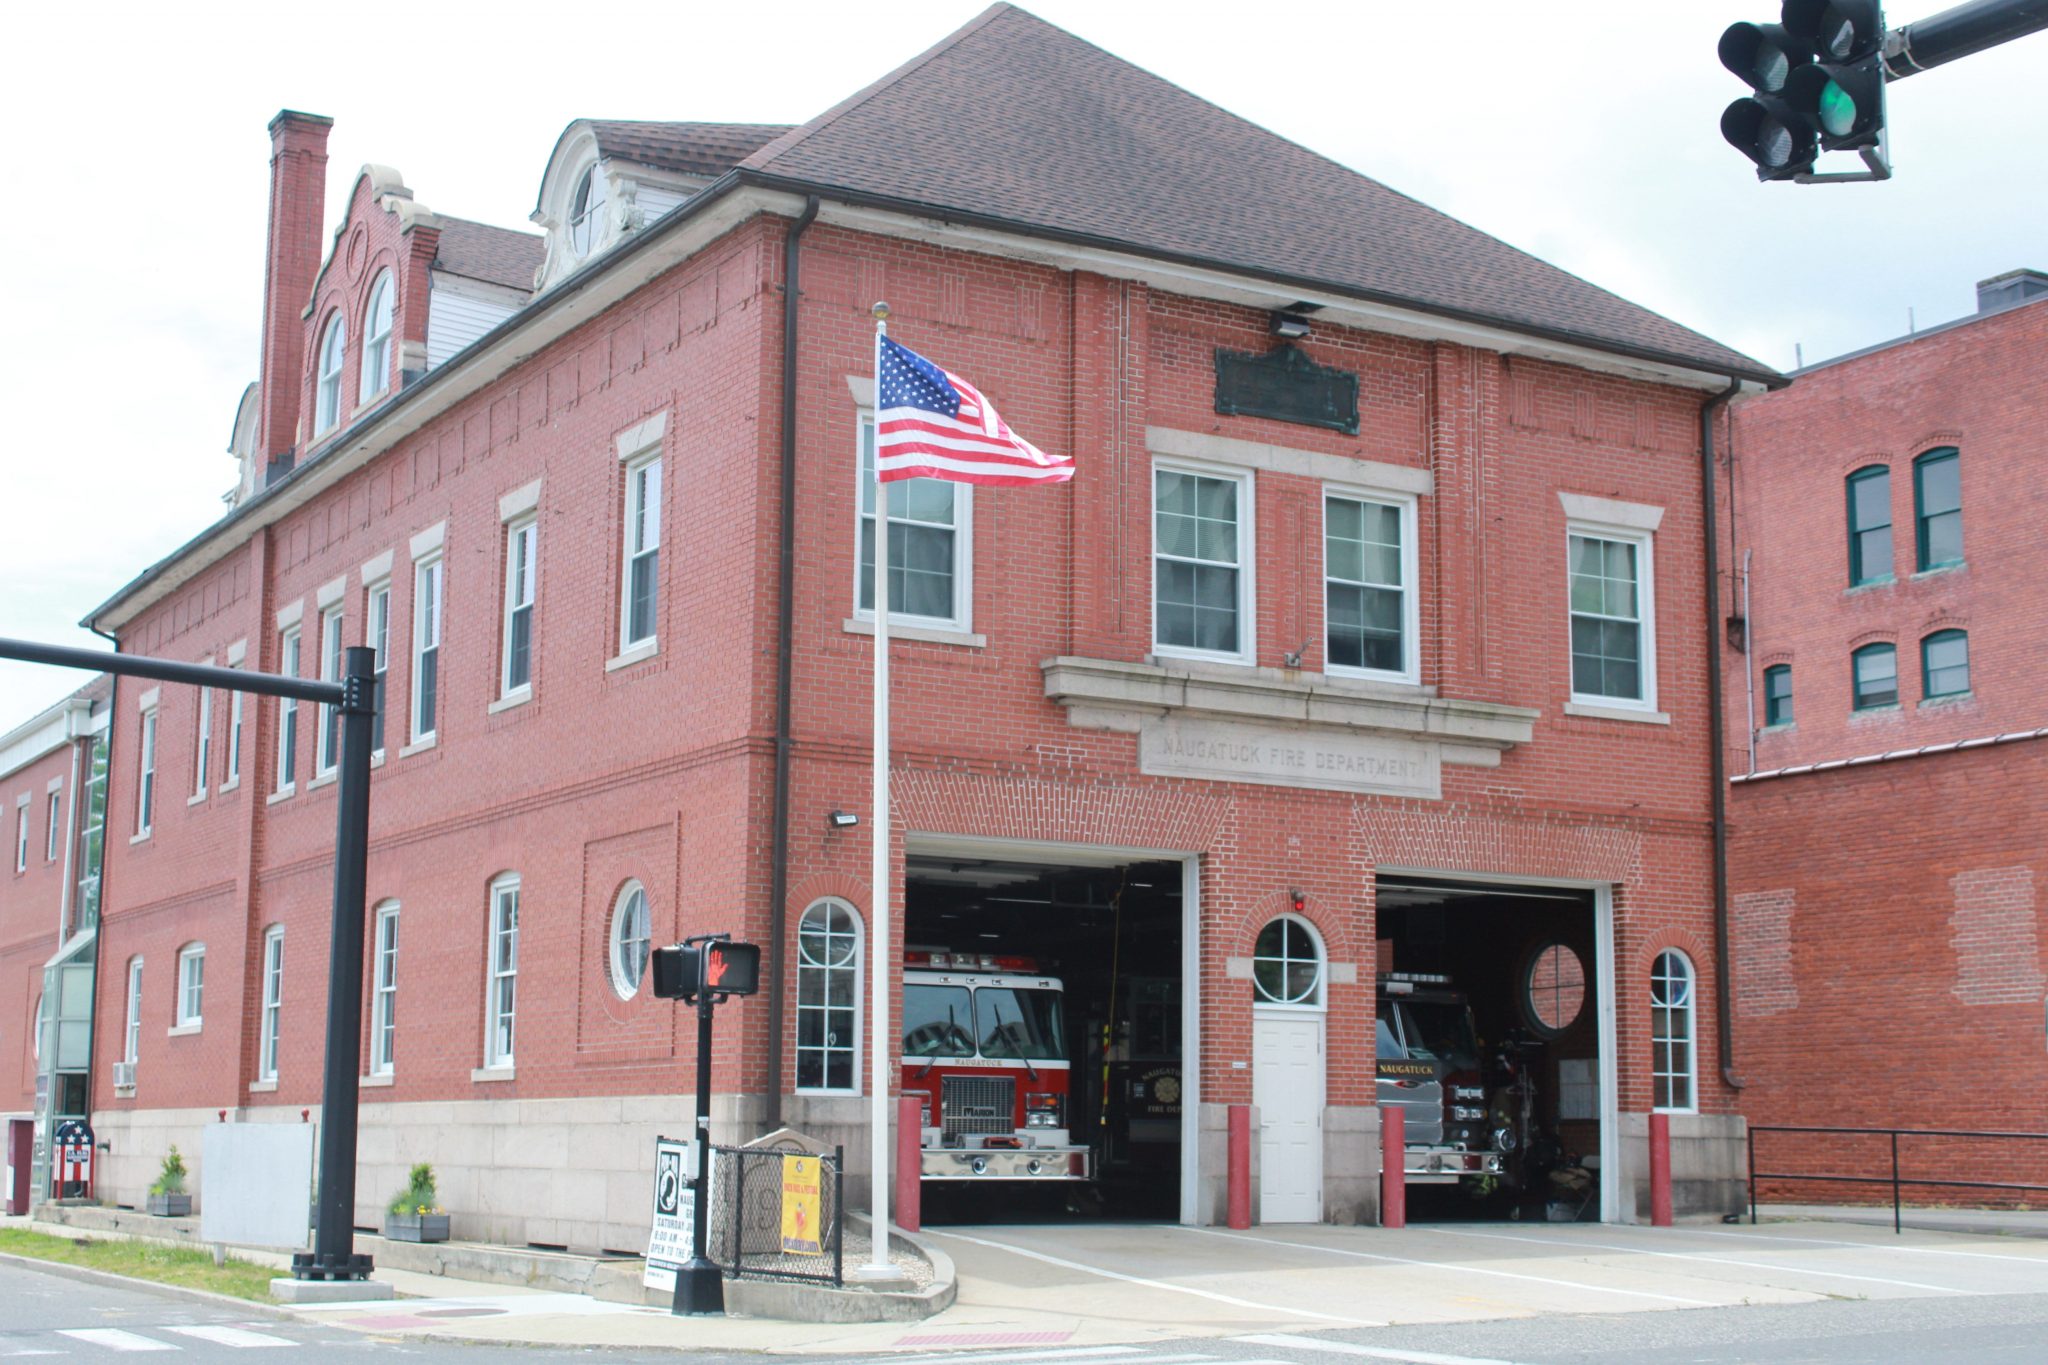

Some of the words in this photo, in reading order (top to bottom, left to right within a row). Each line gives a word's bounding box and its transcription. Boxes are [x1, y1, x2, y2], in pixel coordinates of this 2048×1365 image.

[1163, 736, 1261, 764] NAUGATUCK
[1269, 747, 1306, 767] FIRE
[1316, 752, 1419, 778] DEPARTMENT
[955, 1058, 1003, 1067] NAUGATUCK
[1379, 1064, 1433, 1075] NAUGATUCK
[1141, 1067, 1182, 1081] NAUGATU
[657, 1217, 684, 1231] SATURDAY
[669, 1232, 678, 1242] AM
[650, 1243, 664, 1254] OPEN
[667, 1246, 673, 1256] TO
[675, 1247, 685, 1258] THE
